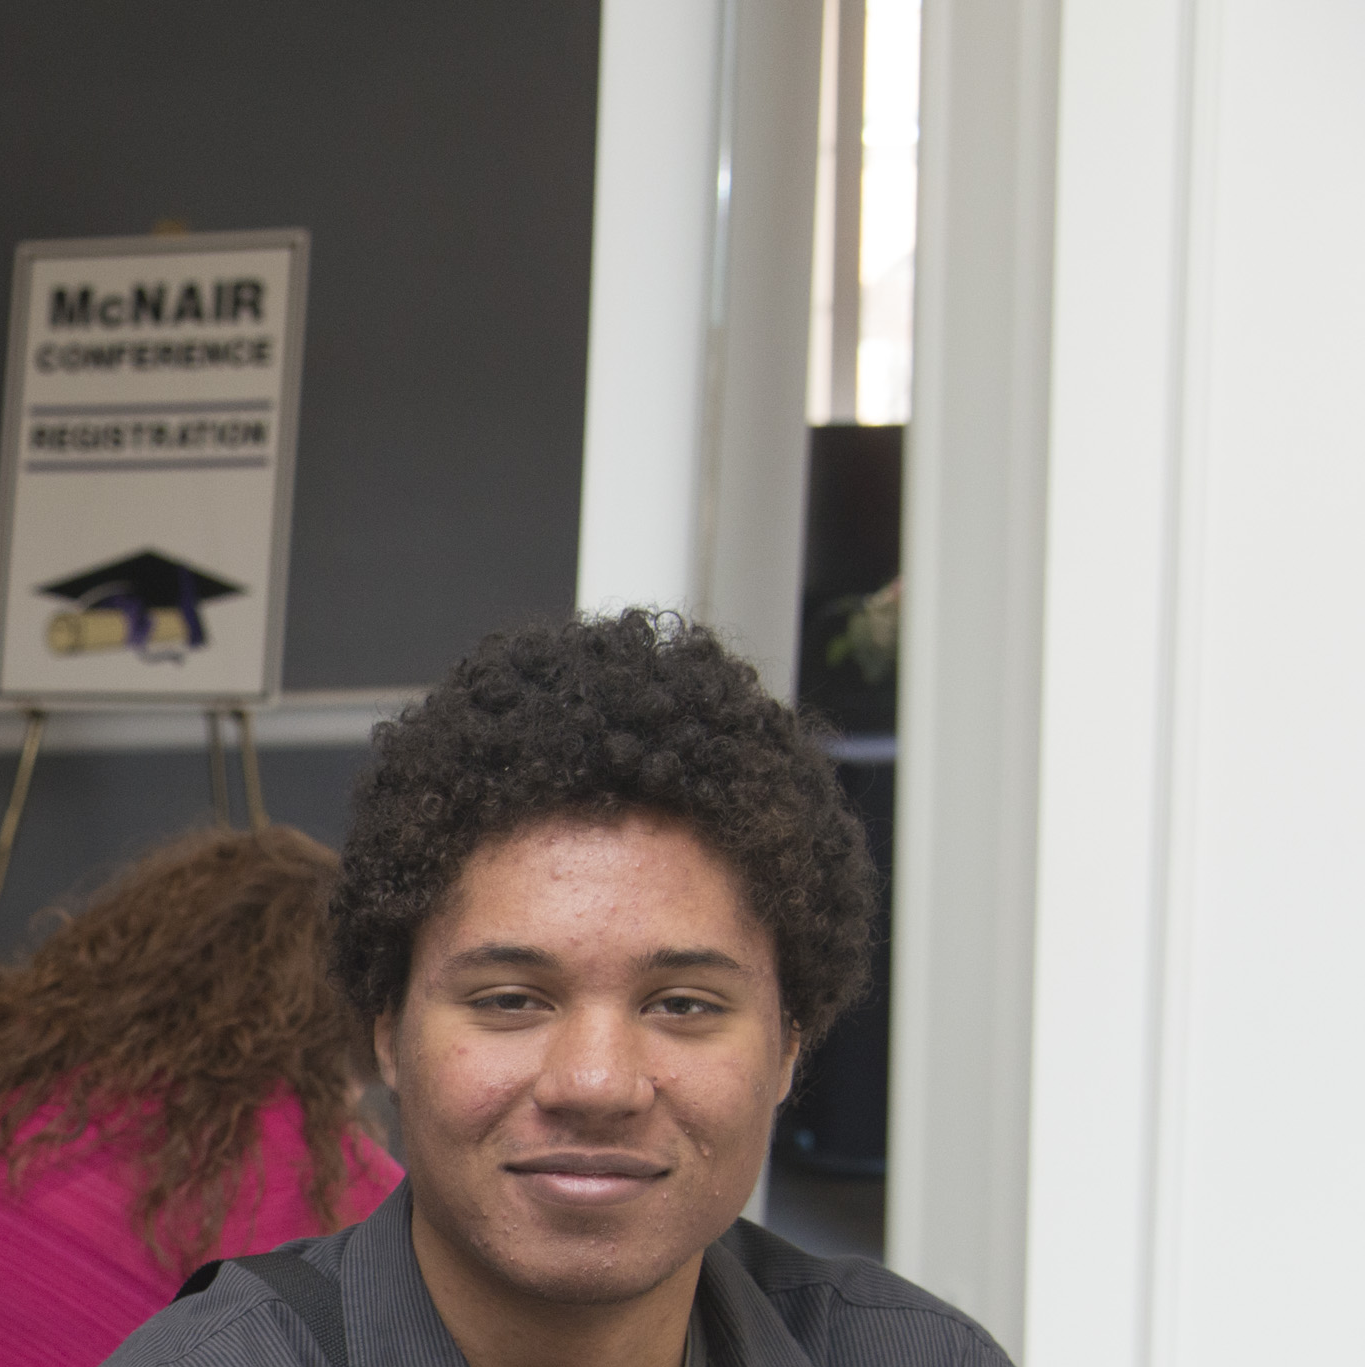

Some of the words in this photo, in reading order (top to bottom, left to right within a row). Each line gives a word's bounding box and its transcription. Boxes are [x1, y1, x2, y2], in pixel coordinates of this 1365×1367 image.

[50, 278, 263, 330] McNAIR
[35, 337, 270, 374] CONFERENCE
[32, 420, 263, 449] REGISTRATION
